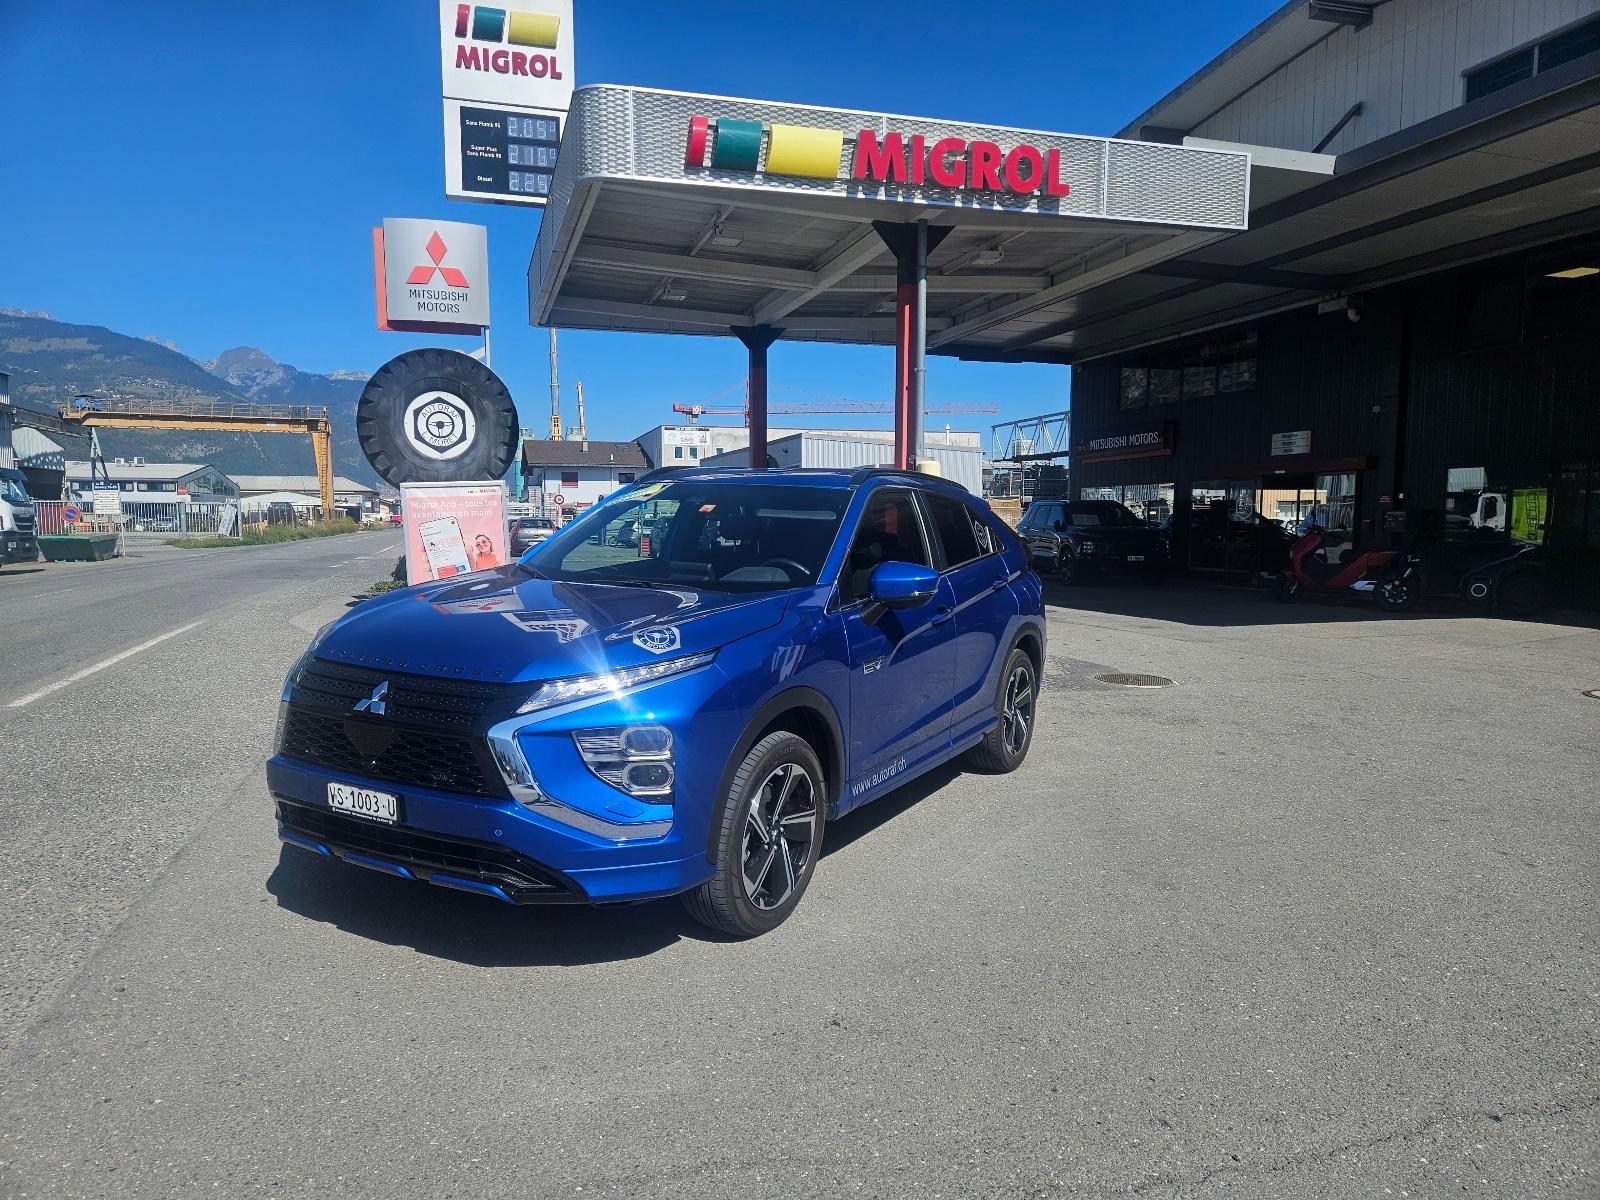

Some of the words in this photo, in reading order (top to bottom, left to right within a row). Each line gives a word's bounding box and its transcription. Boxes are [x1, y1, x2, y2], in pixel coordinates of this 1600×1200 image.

[455, 45, 562, 80] MIGROL
[479, 120, 494, 128] Plomb
[470, 144, 486, 152] Super
[851, 129, 1070, 198] MIGROL
[408, 288, 468, 302] MITSUBISHI
[417, 301, 460, 313] MOTORS
[421, 403, 460, 419] AUTORAF
[429, 433, 458, 446] MORET
[1089, 435, 1128, 452] MITSUBISHI
[1129, 431, 1160, 447] MOTORS
[852, 757, 906, 795] www.autoraf.ch
